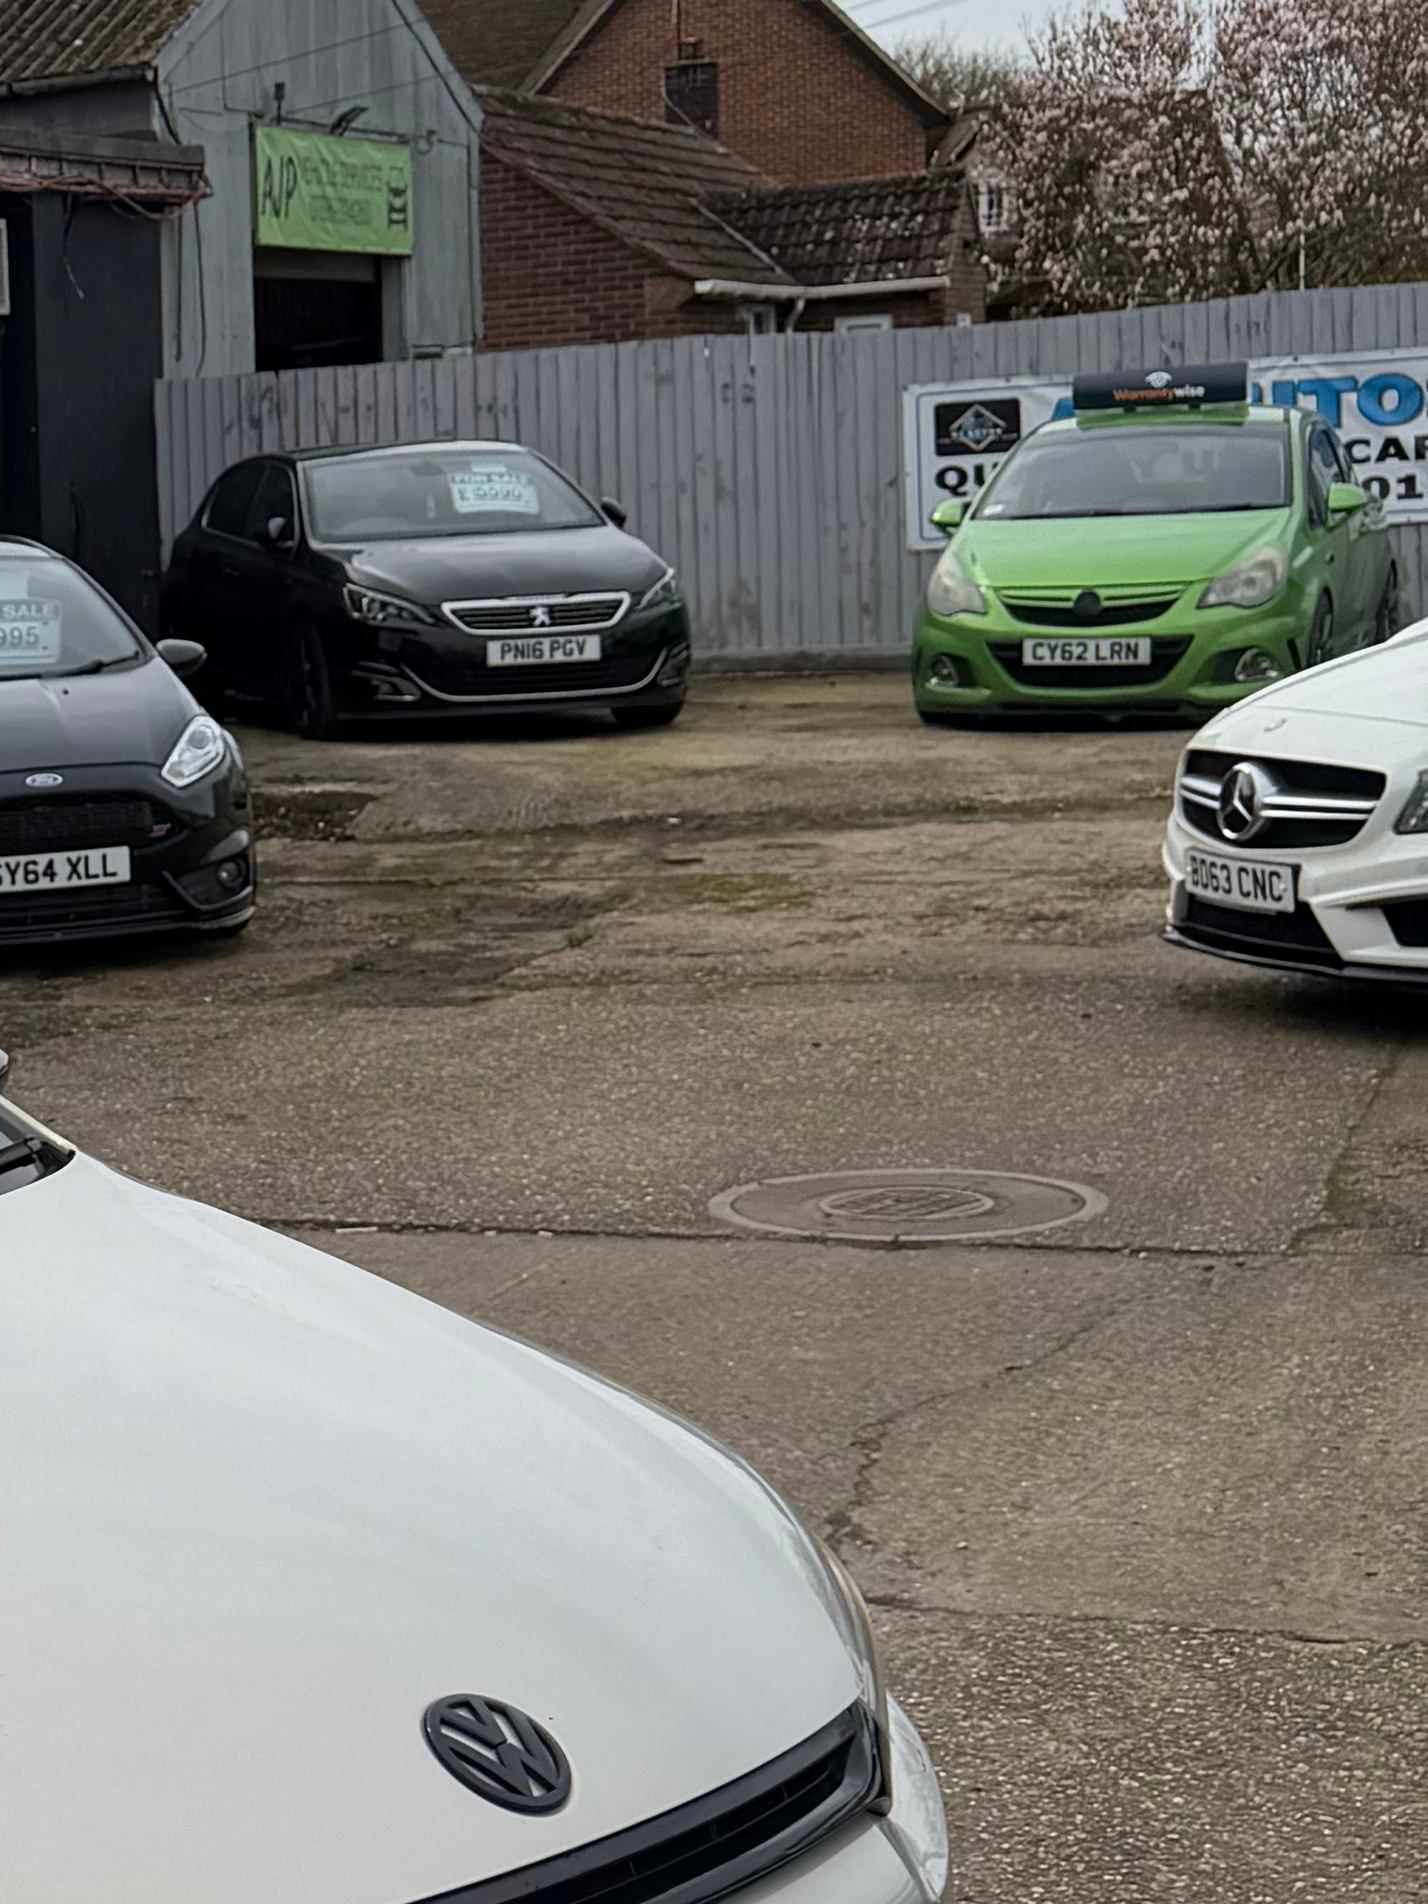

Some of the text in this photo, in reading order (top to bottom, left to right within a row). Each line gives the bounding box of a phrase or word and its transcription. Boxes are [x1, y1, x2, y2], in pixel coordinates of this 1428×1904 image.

[261, 155, 298, 220] AJP
[2, 603, 53, 619] SALE
[500, 637, 586, 661] PN16 PGV
[1032, 641, 1139, 661] CY62 LRN
[66, 853, 118, 882] XLL
[1237, 866, 1283, 902] CNC
